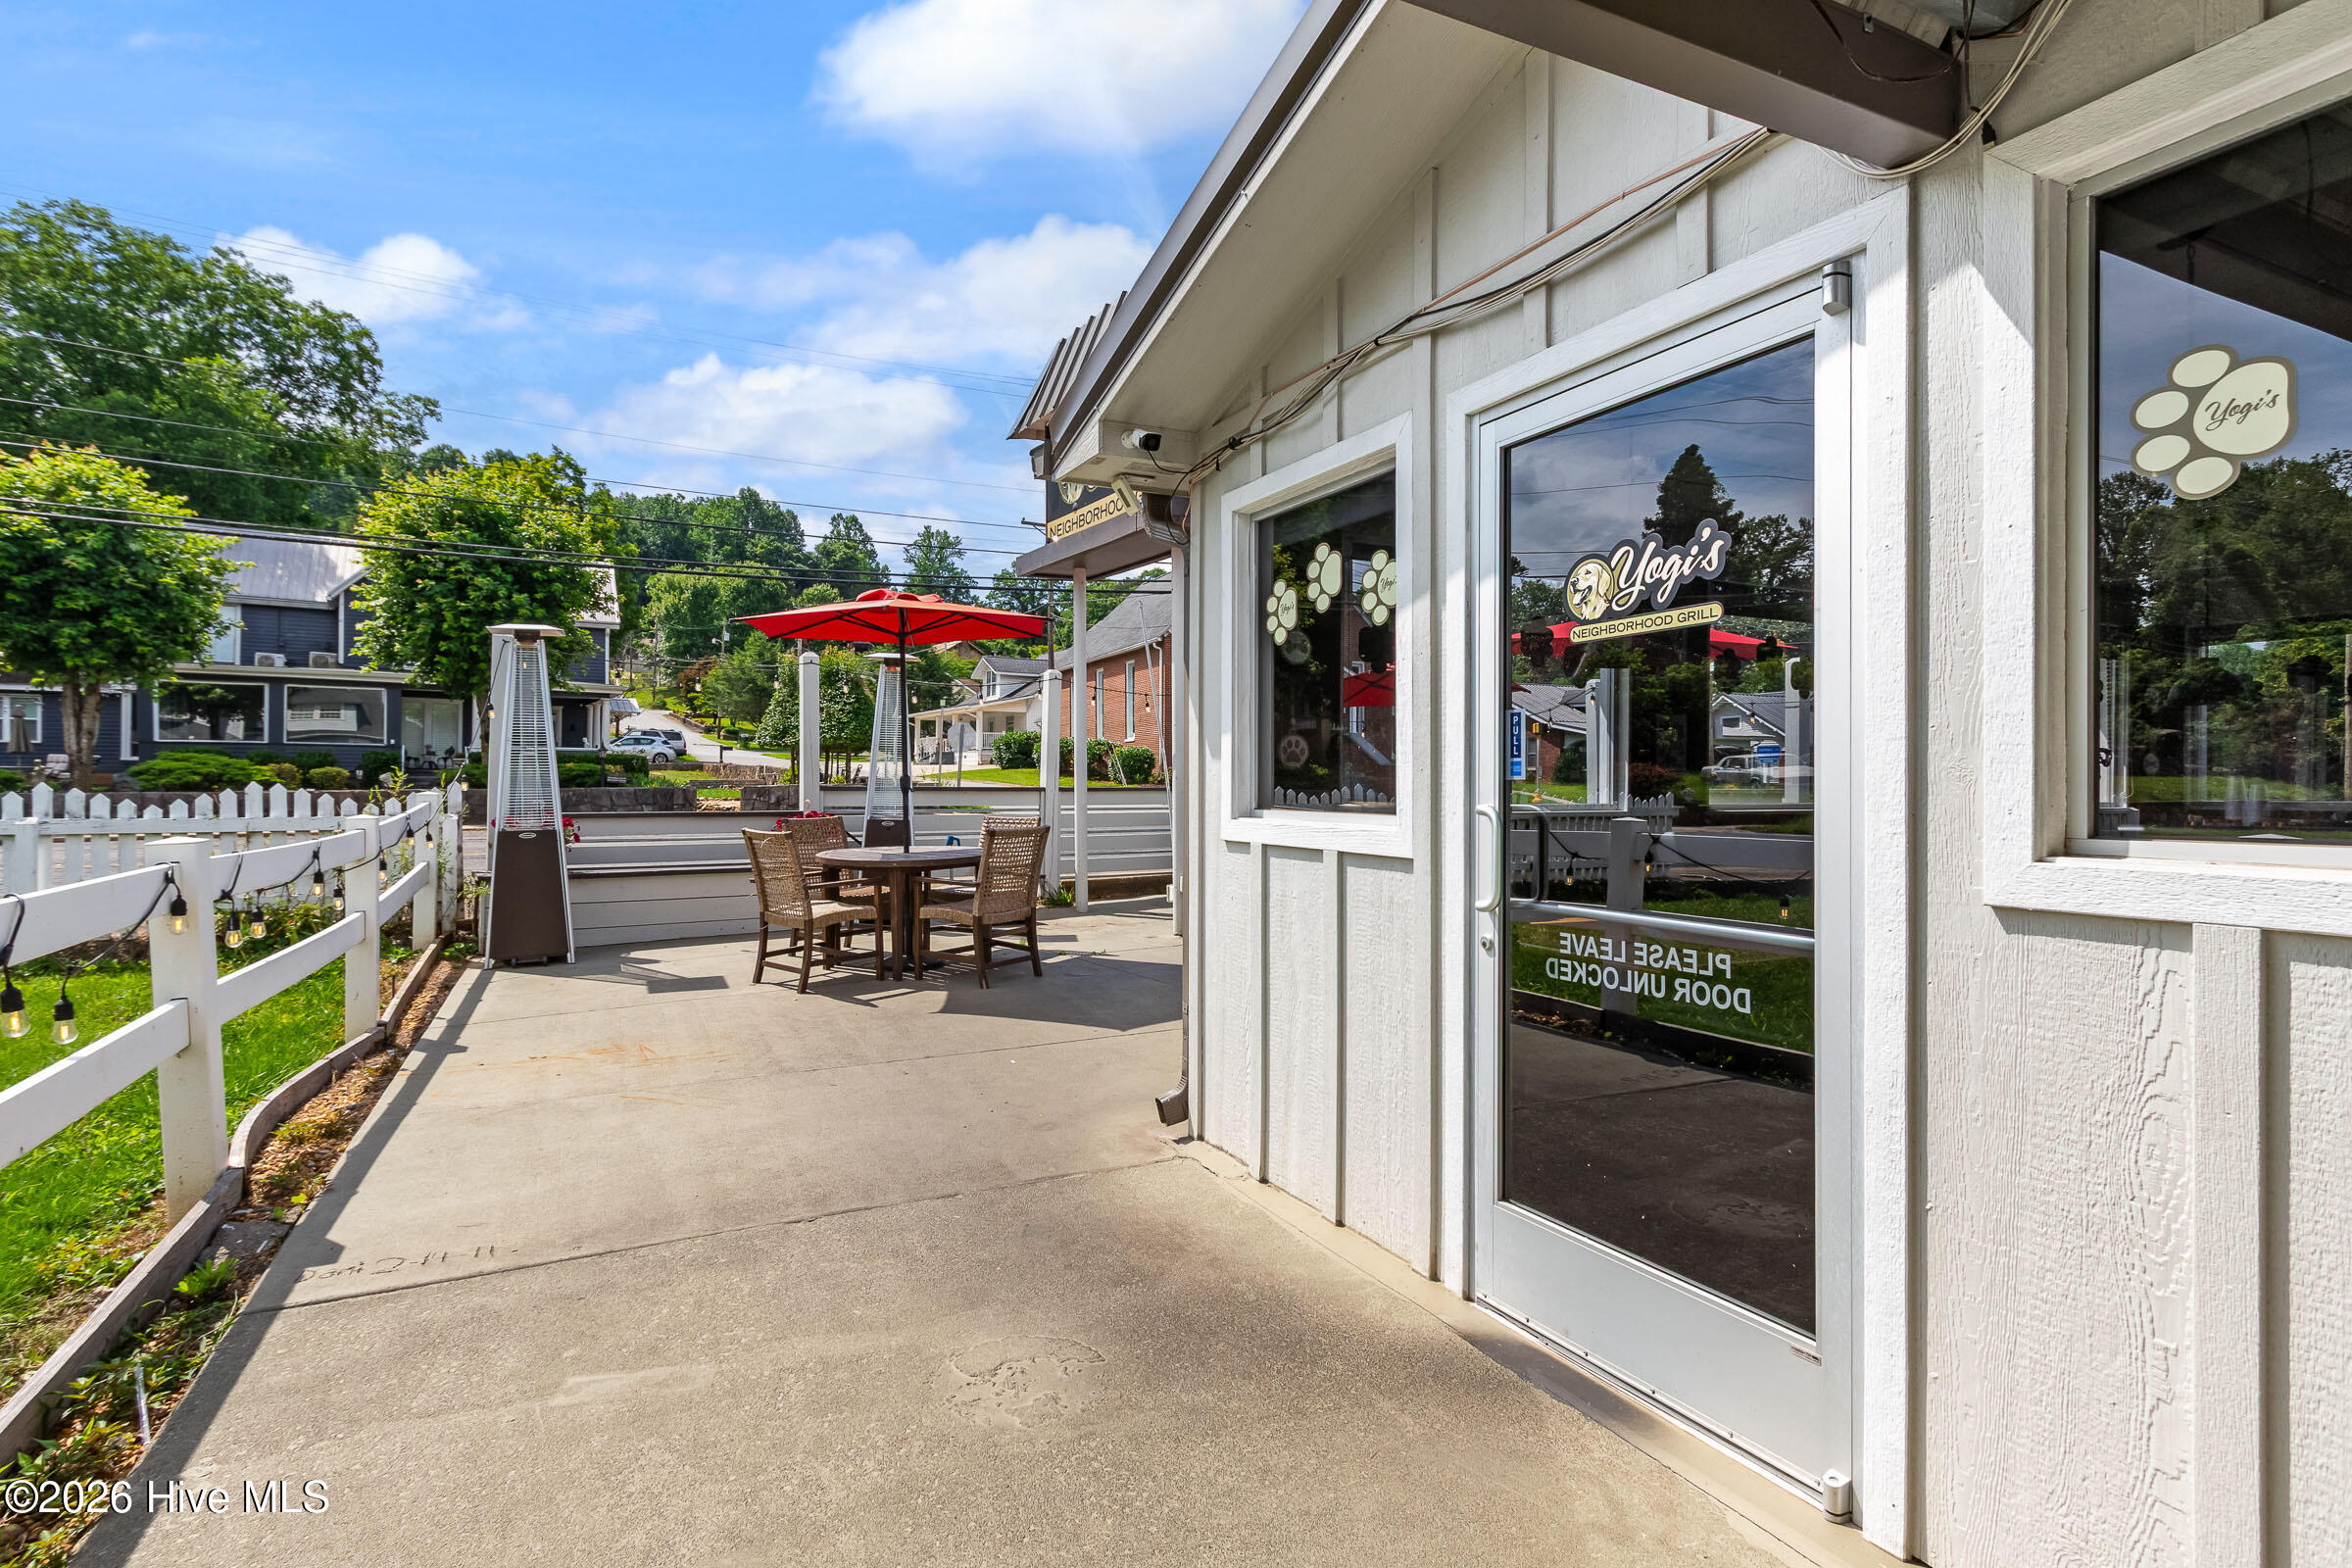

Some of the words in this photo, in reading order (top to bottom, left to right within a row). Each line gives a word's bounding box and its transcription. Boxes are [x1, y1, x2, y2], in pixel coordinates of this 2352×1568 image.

[2205, 389, 2279, 431] Yogi's
[1050, 497, 1126, 537] NEIGHBORHOO
[1610, 526, 1725, 612] Yogi's
[1572, 614, 1674, 640] NEIGHBORHOOD
[1677, 608, 1719, 622] GRILL
